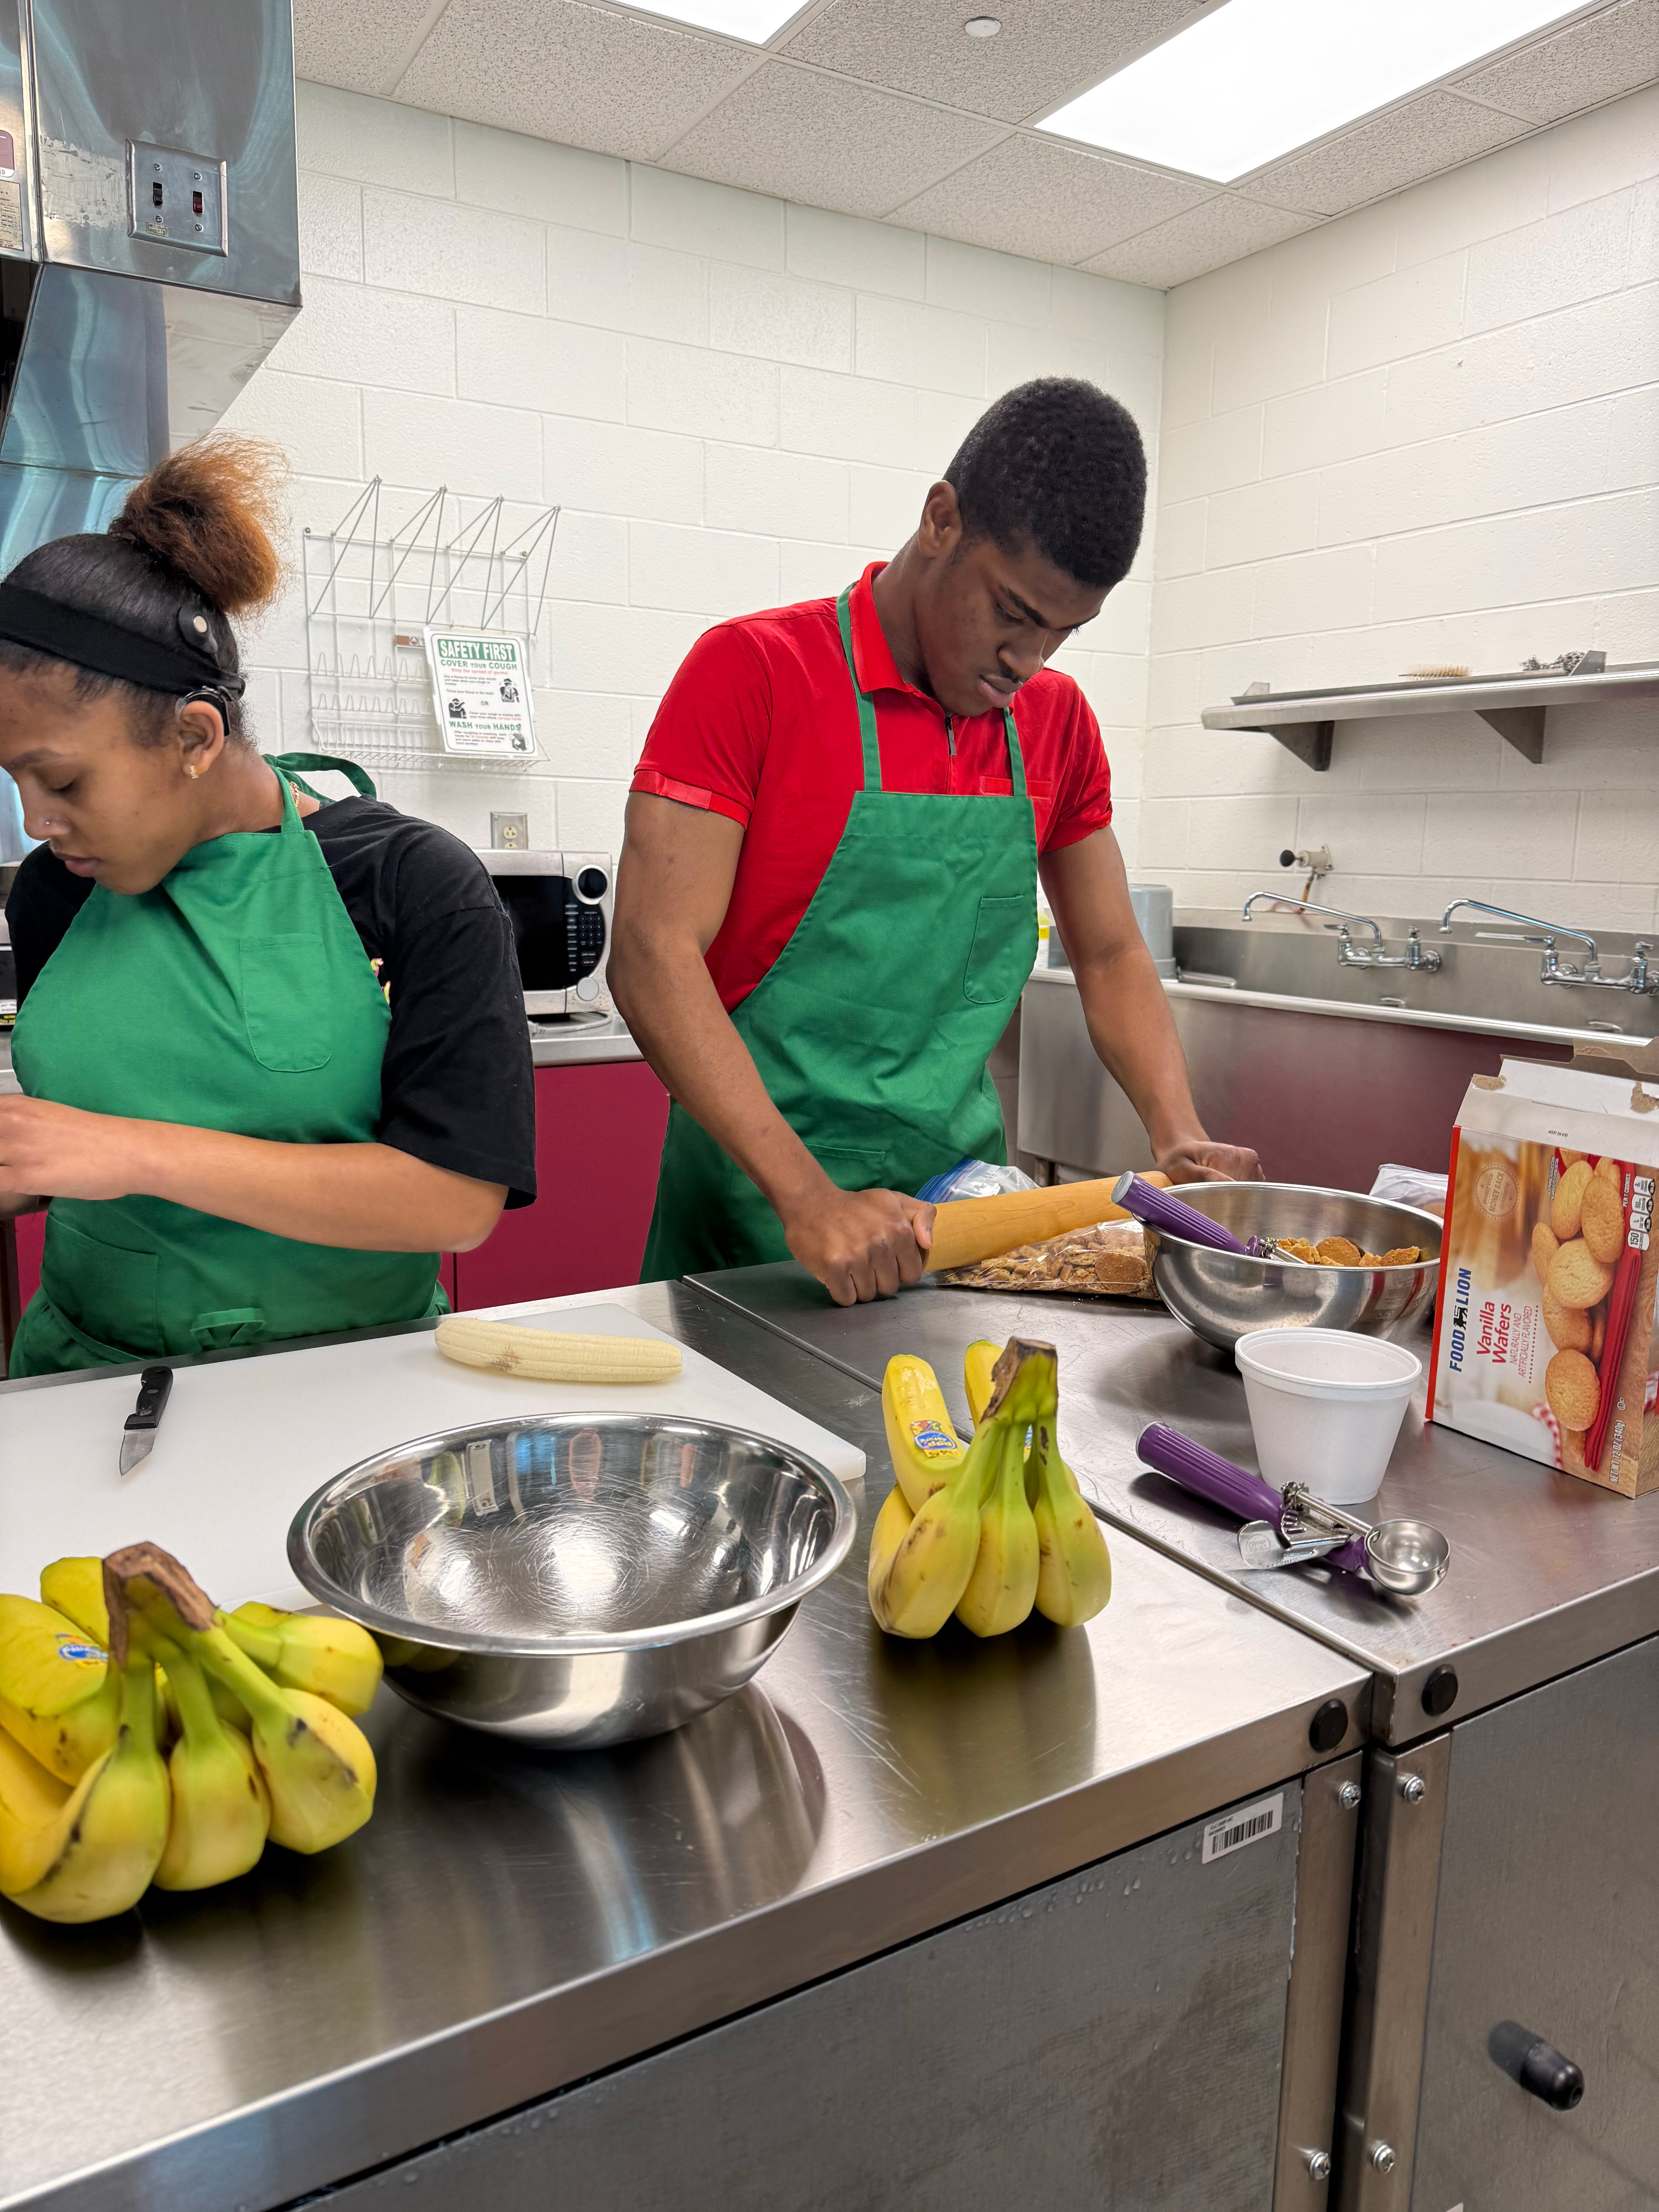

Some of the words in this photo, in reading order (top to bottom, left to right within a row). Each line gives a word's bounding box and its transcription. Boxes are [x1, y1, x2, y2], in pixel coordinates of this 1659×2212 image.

[440, 640, 480, 659] SAFETY
[483, 643, 512, 661] FIRST
[441, 659, 468, 667] COVER
[449, 721, 472, 729] WASH
[1494, 1172, 1504, 1189] BACK
[1489, 1189, 1500, 1212] MONEY
[1630, 1233, 1639, 1245] 150
[1456, 1267, 1472, 1306] LION
[1476, 1302, 1495, 1355] Vanilla
[1513, 1313, 1522, 1328] AND
[1522, 1306, 1532, 1339] FLAVORED
[1492, 1304, 1511, 1364] Wafers
[1449, 1329, 1465, 1372] FOOD
[1509, 1328, 1519, 1364] NATURALLY
[1518, 1339, 1529, 1378] ARTIFICIALLY
[1613, 1420, 1626, 1441] (340g)
[1612, 1450, 1621, 1459] 12
[1613, 1441, 1622, 1451] OZ
[1610, 1459, 1620, 1471] WT
[1609, 1470, 1619, 1483] NET
